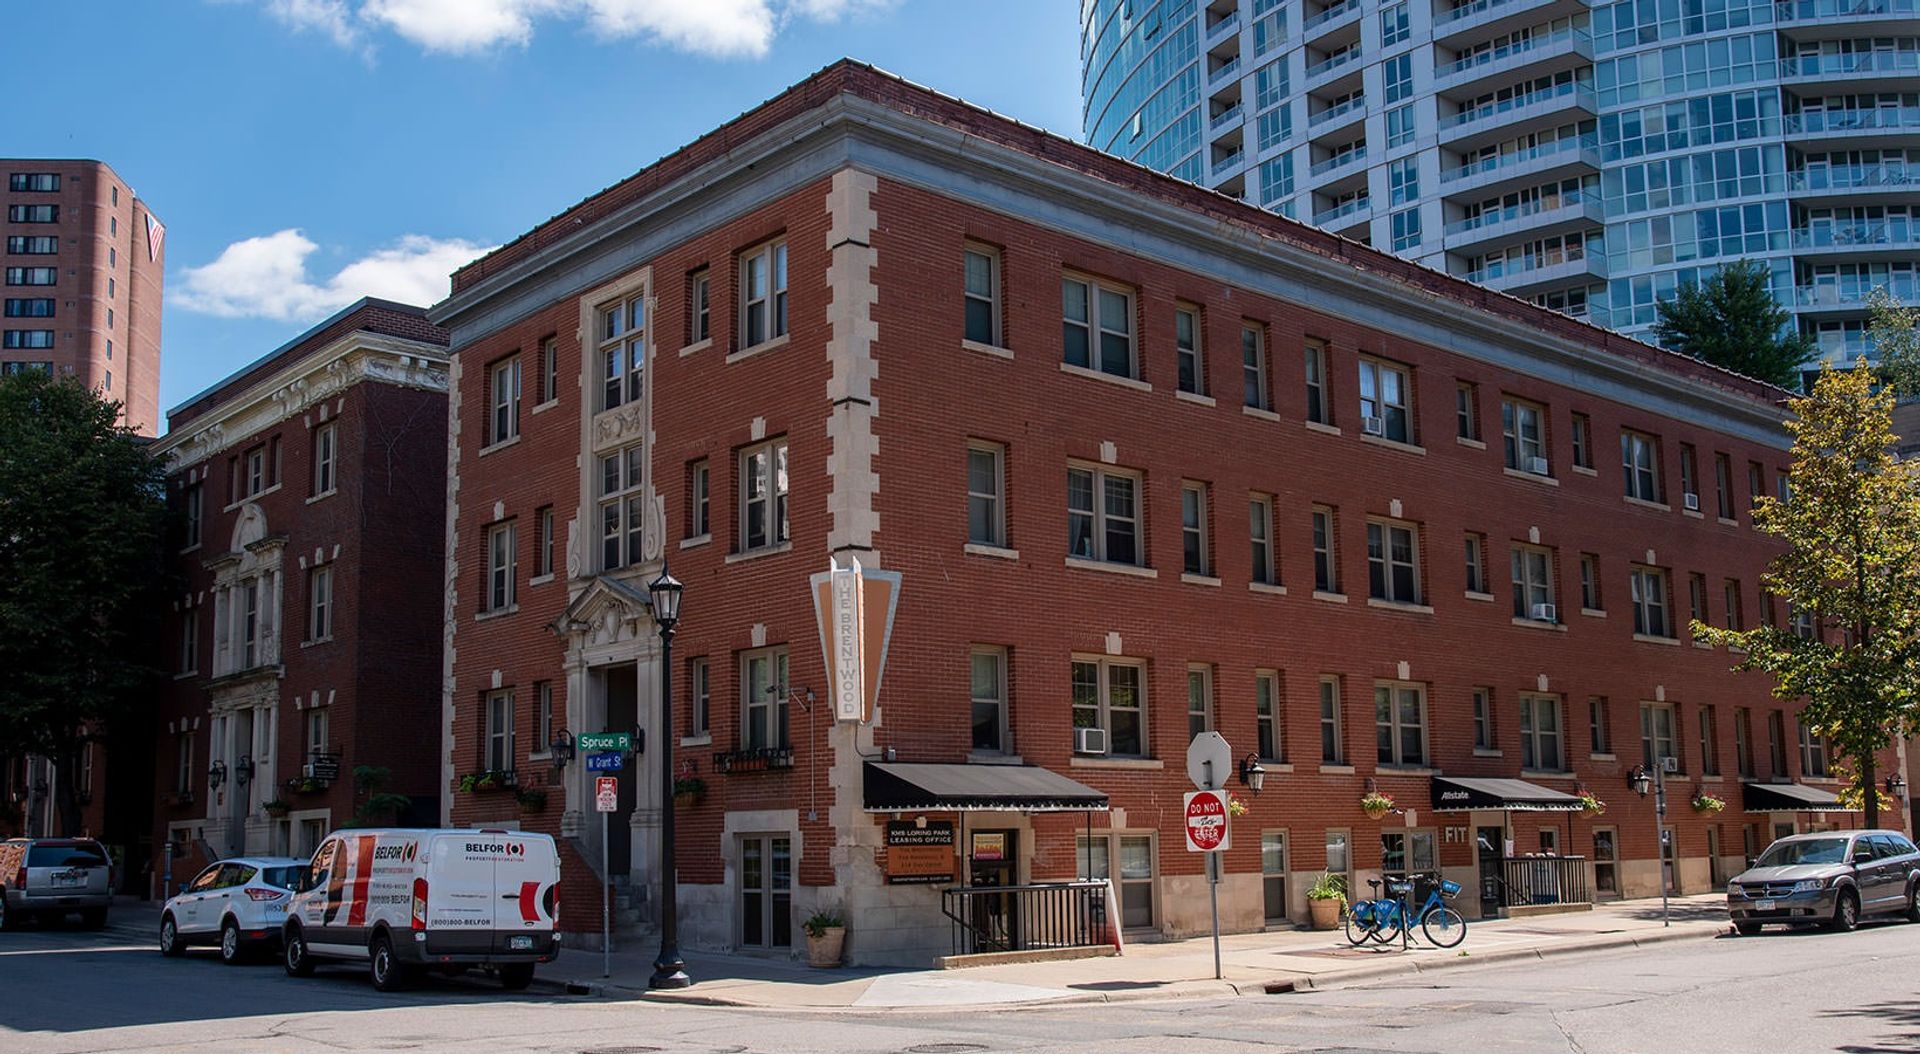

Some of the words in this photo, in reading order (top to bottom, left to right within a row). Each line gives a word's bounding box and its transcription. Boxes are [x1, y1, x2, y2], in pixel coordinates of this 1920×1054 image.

[839, 575, 851, 609] THE
[840, 613, 856, 714] BRENTWOOD
[582, 736, 614, 749] Spruce
[619, 736, 628, 747] Pl
[596, 757, 612, 768] Grant
[614, 756, 622, 767] St
[1441, 791, 1470, 801] Allstate
[1190, 804, 1201, 814] DO
[1203, 802, 1219, 813] NOT
[1195, 828, 1219, 841] ENTER
[1445, 826, 1467, 843] FIT
[375, 846, 403, 859] BELFOR
[466, 843, 504, 853] BELFOR
